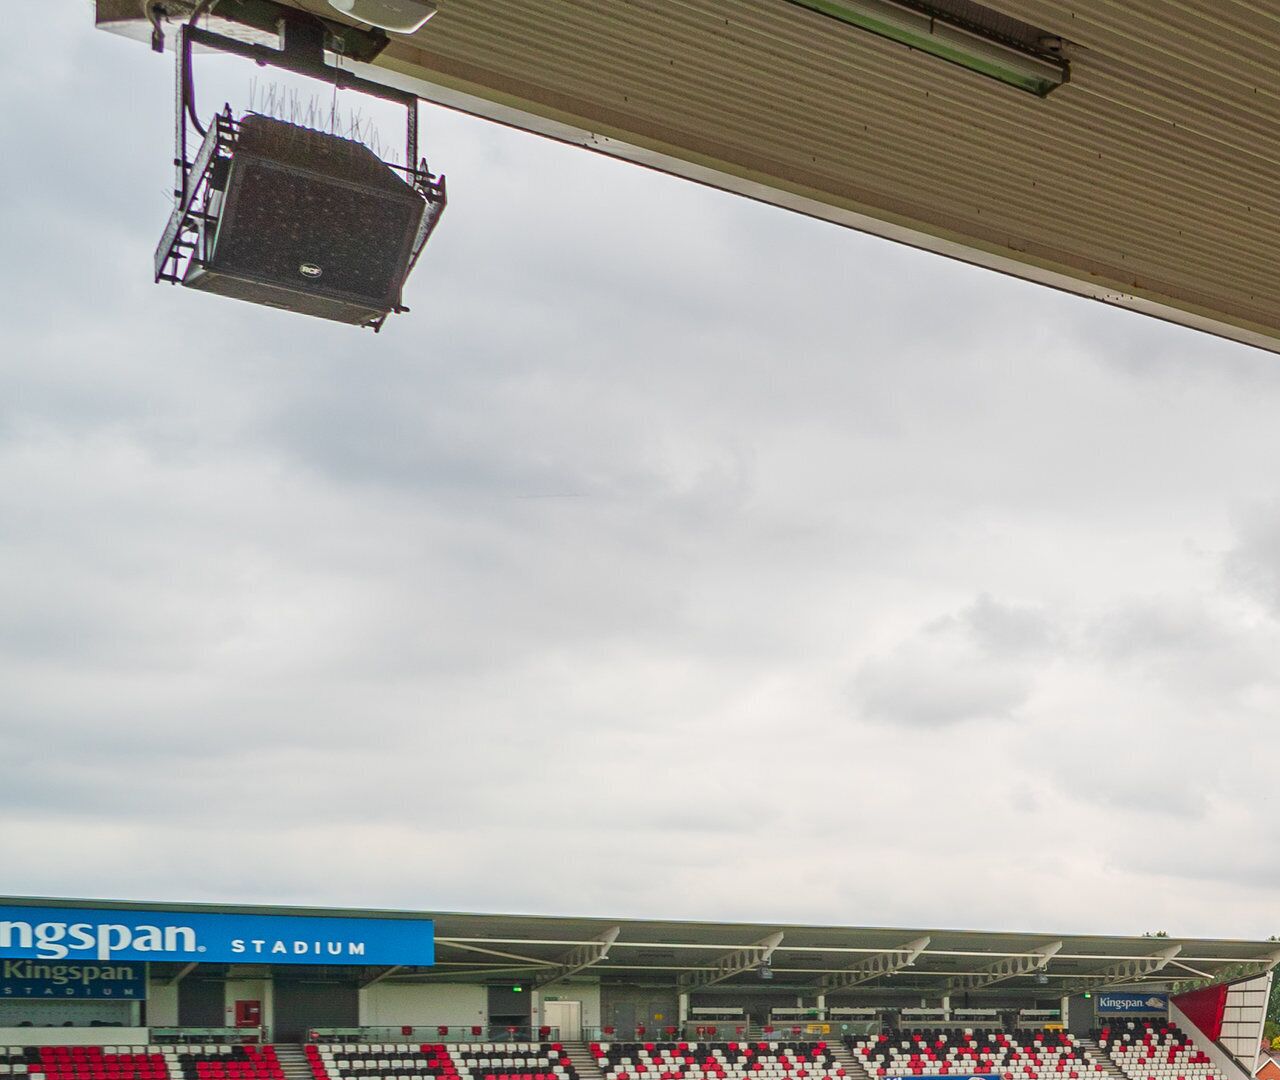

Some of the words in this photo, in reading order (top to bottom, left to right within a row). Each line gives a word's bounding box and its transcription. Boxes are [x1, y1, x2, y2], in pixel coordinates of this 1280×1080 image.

[231, 938, 366, 956] STADIUM
[3, 959, 134, 986] Kingspan
[1100, 997, 1143, 1010] Kingspan
